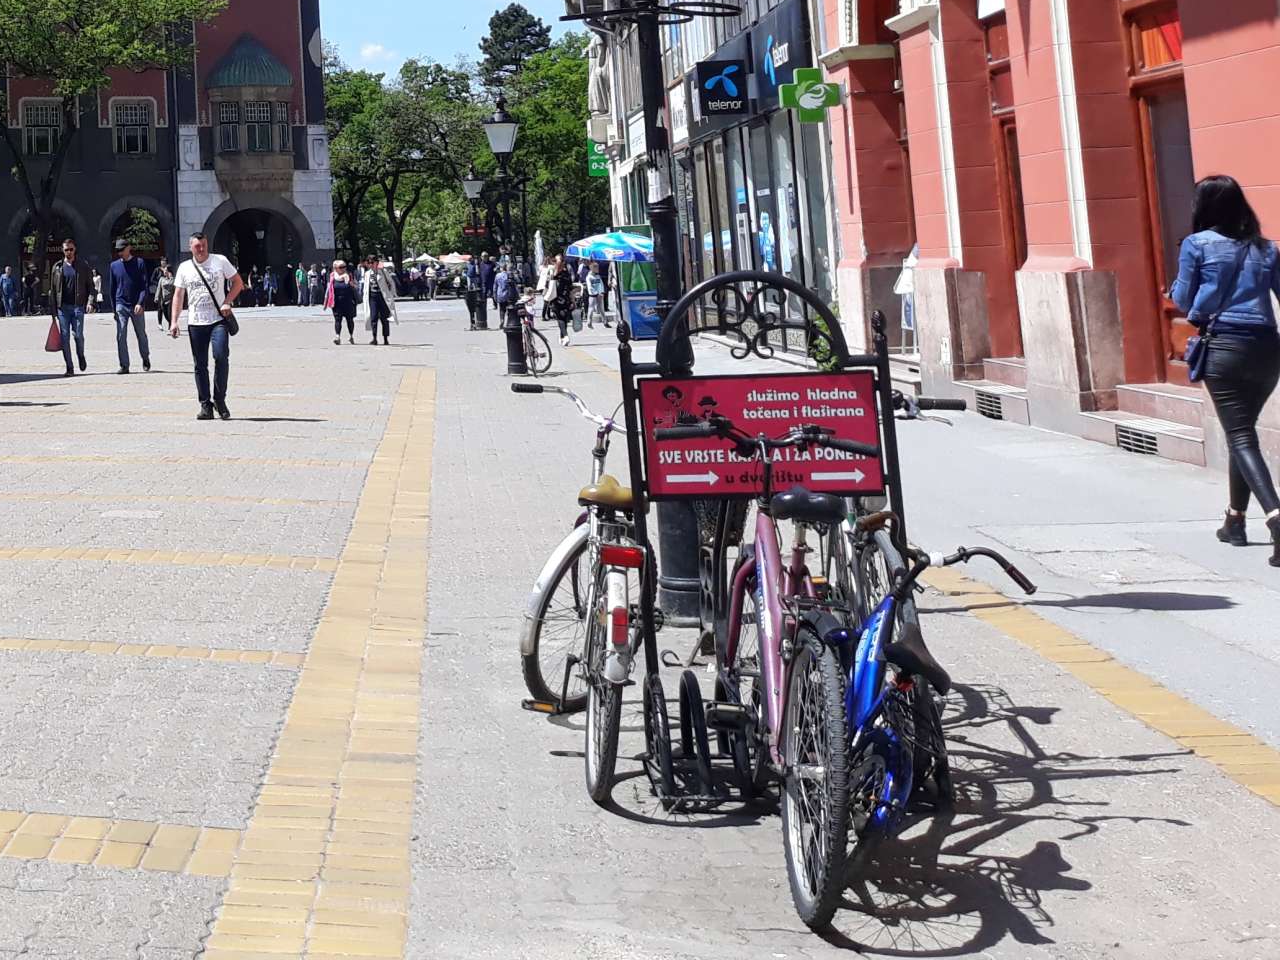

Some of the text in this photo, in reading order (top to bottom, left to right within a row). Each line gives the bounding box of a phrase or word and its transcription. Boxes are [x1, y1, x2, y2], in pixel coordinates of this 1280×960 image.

[707, 98, 743, 111] telenor
[746, 387, 858, 402] služimo hladna
[742, 402, 865, 419] točena i flaširana
[658, 449, 681, 465] SVE
[684, 448, 725, 464] VRSTE
[785, 448, 791, 461] I
[794, 448, 812, 461] ZA
[725, 474, 735, 484] u
